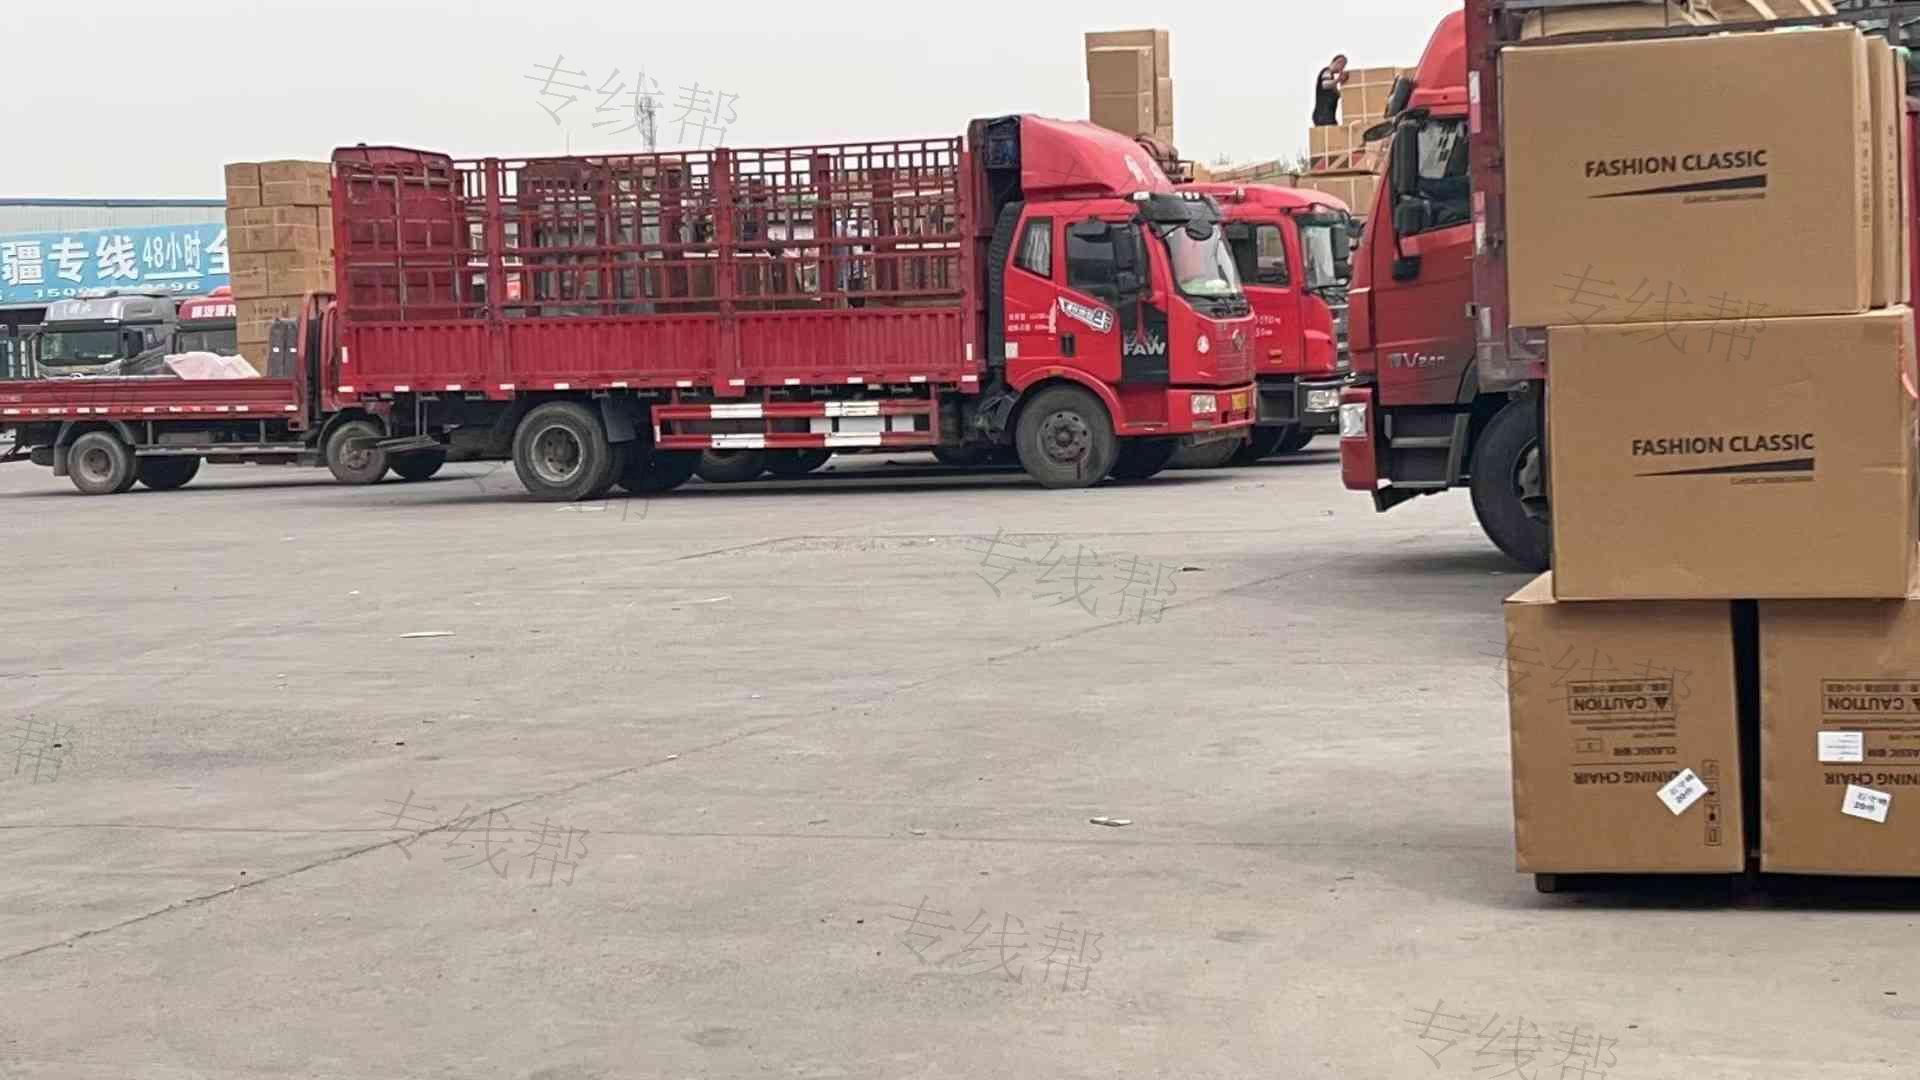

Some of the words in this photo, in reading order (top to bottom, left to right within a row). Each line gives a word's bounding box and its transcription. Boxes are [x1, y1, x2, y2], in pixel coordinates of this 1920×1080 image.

[1585, 156, 1677, 178] FASHION
[1682, 149, 1768, 172] CLASSIC
[143, 229, 201, 271] 48小时
[1123, 336, 1166, 355] FAW
[1632, 438, 1724, 457] FASHION
[1730, 433, 1815, 453] CLASSIC
[1573, 698, 1648, 711] CAUTION
[1827, 697, 1905, 711] CAUTION
[1573, 772, 1620, 785] CHAIR
[1824, 772, 1873, 786] CHAIR
